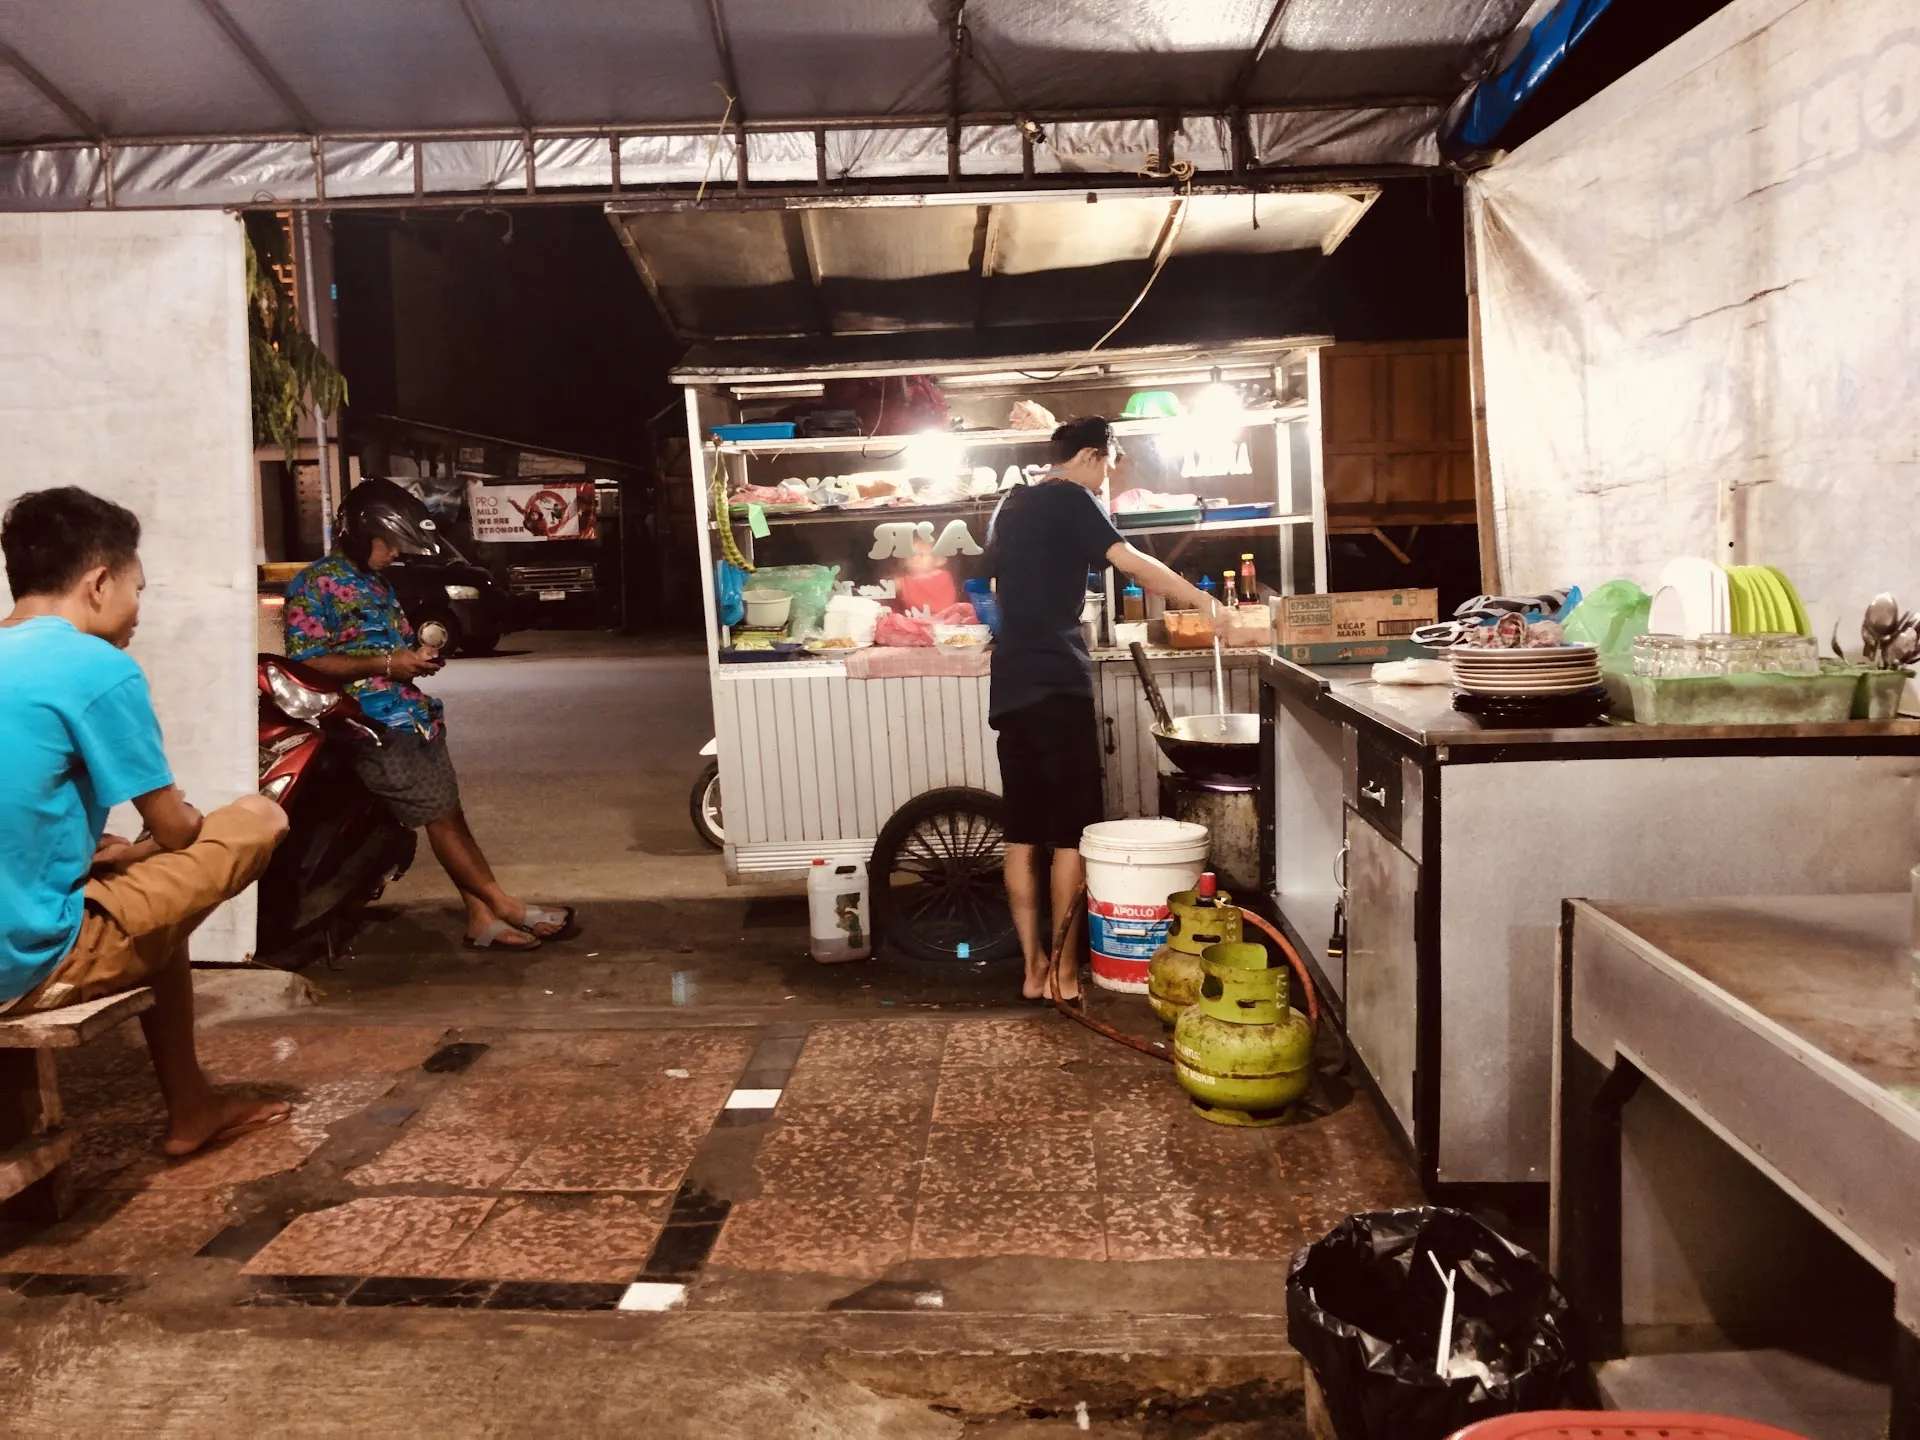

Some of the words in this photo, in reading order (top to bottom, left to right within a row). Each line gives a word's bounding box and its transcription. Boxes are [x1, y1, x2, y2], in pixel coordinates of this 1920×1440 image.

[476, 496, 498, 507] PRO
[477, 508, 499, 516] MILD
[478, 526, 525, 535] STRONGER
[1336, 622, 1366, 630] KECAP
[1336, 629, 1367, 638] MANIS
[1112, 906, 1155, 918] APOLLO
